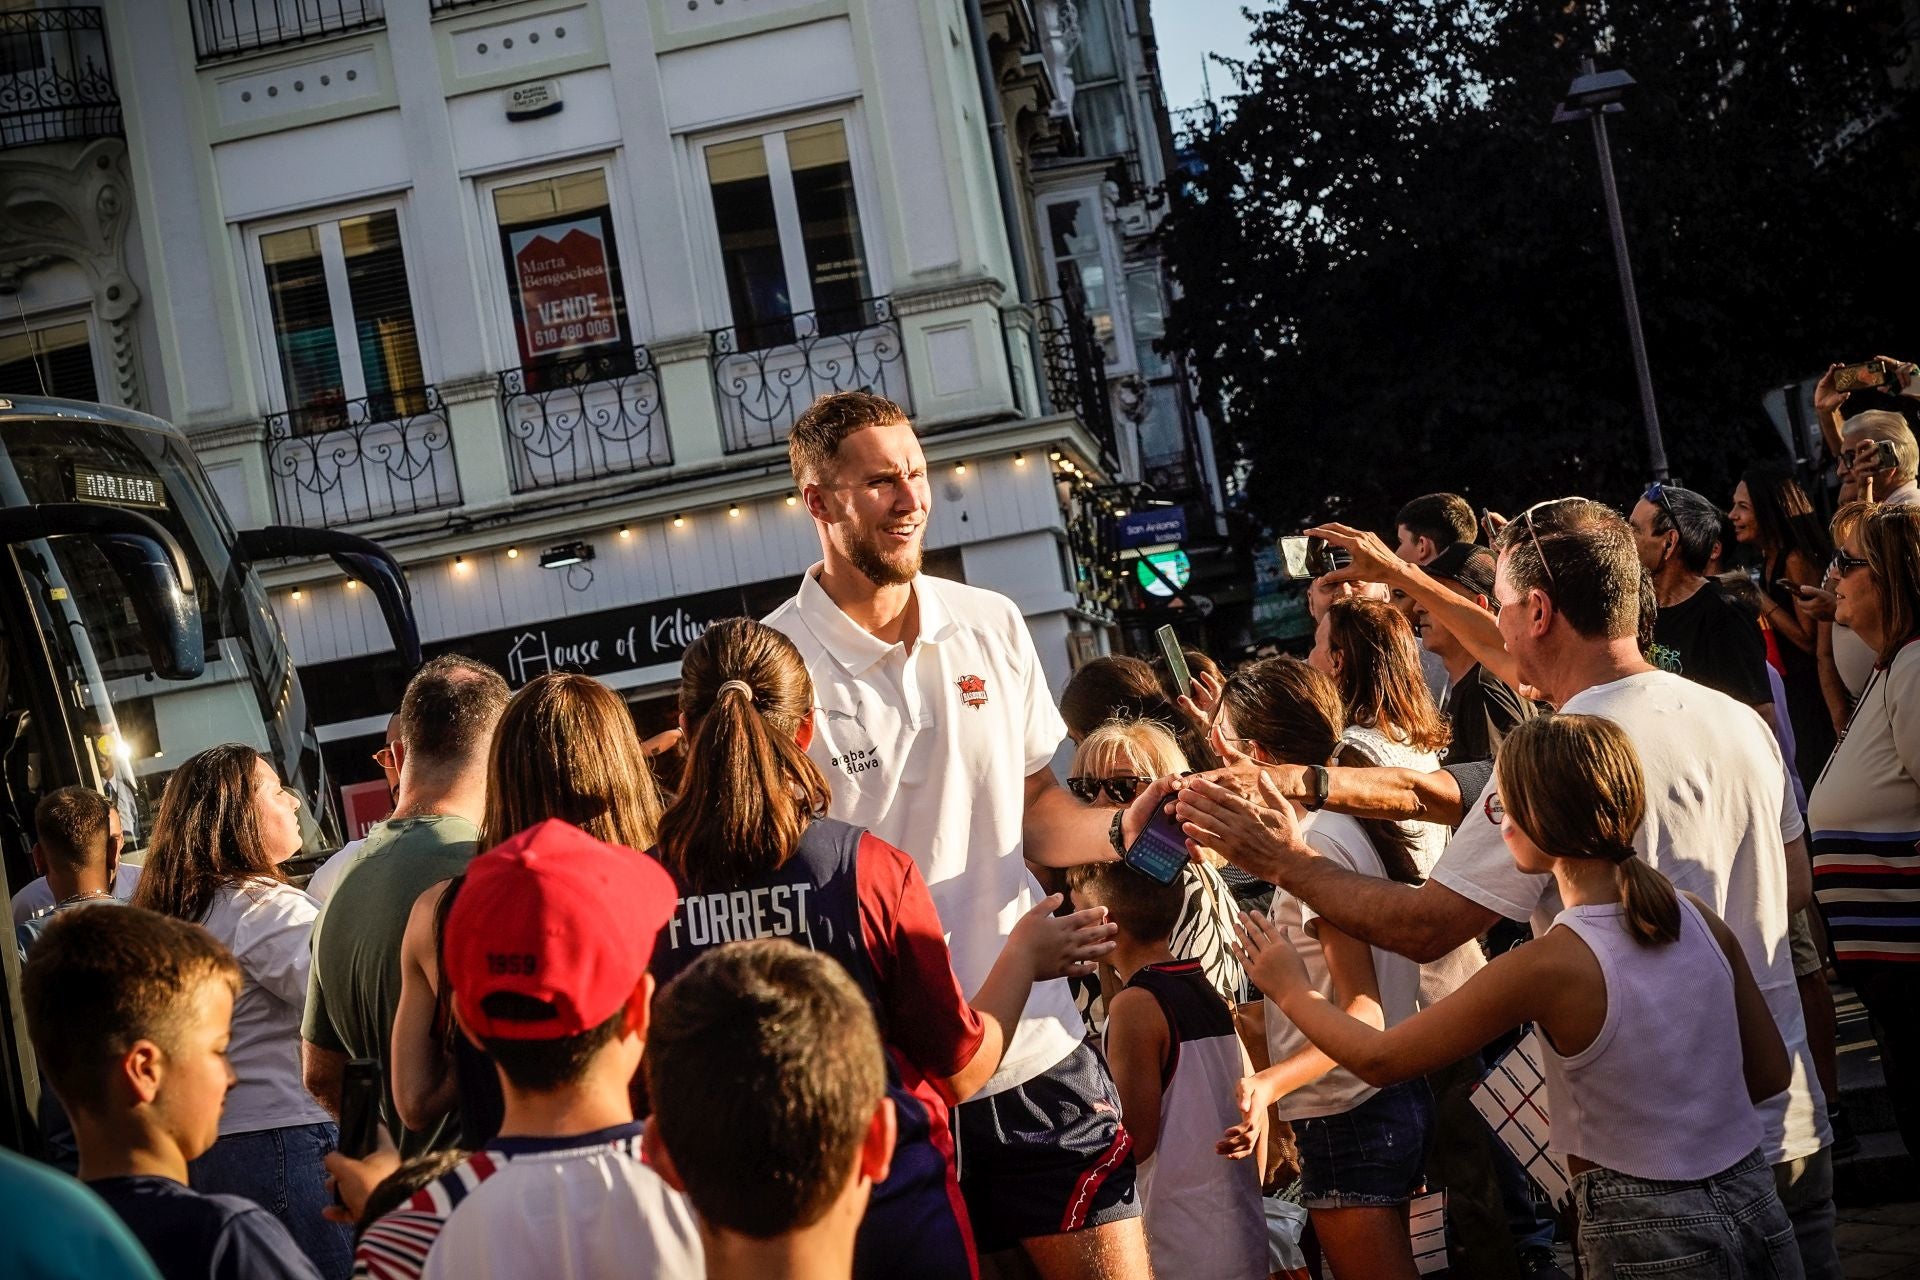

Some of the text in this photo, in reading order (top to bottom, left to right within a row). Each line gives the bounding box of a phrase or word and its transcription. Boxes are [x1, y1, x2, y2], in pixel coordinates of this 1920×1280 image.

[522, 258, 566, 274] Marta
[524, 265, 604, 288] Bengochea
[537, 293, 600, 326] VENDE
[535, 327, 558, 347] 610
[586, 318, 611, 337] 006
[86, 474, 156, 502] ARRIAGA
[507, 631, 600, 683] House
[615, 626, 637, 664] of
[831, 750, 865, 767] araba
[669, 883, 811, 950] FORREST
